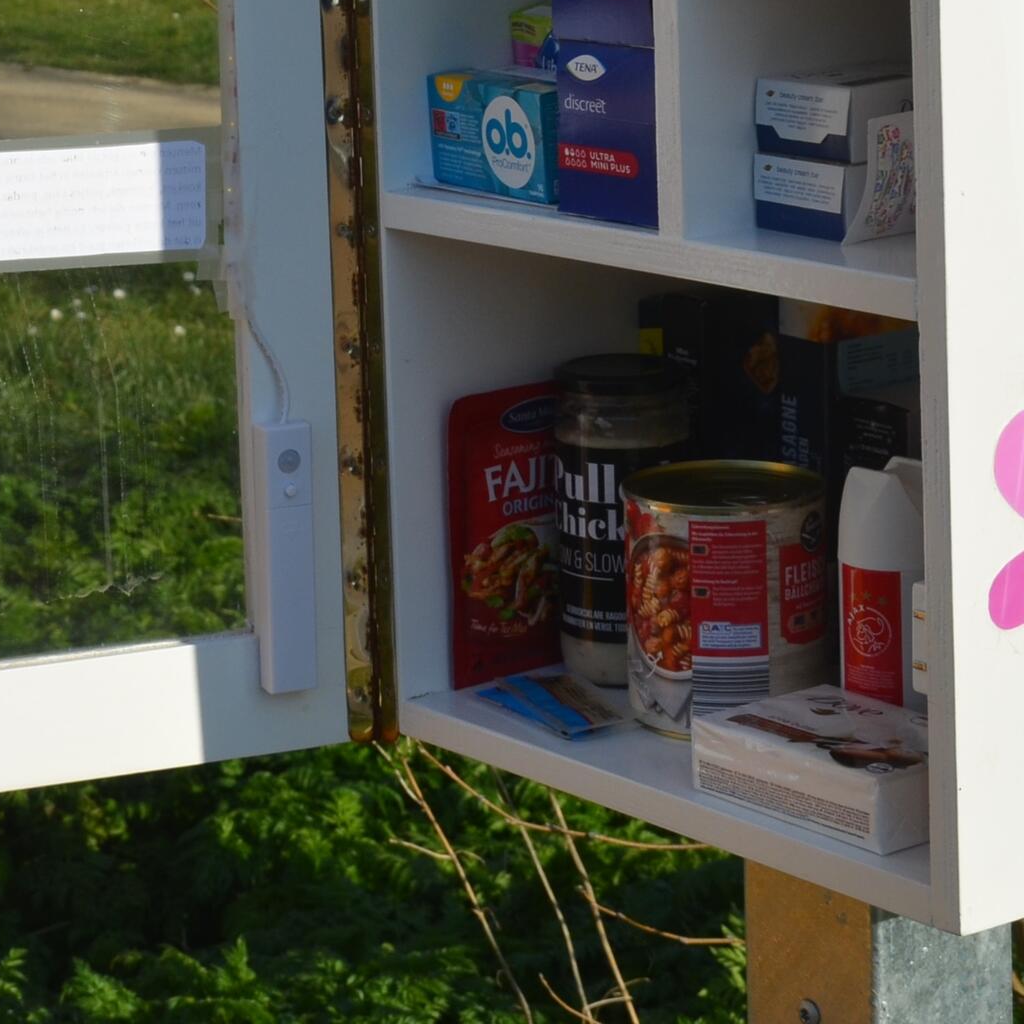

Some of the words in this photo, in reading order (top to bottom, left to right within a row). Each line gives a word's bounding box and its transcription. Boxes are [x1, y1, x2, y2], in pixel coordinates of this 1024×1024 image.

[574, 61, 597, 74] TENA
[564, 95, 607, 115] discreet
[492, 156, 529, 173] ProComfort
[589, 151, 615, 162] ULTRA
[589, 161, 609, 171] MINI
[610, 163, 631, 174] PLUS
[780, 392, 798, 462] SAGNE
[554, 456, 624, 504] Pull
[574, 549, 583, 569] &
[584, 551, 625, 574] SLOW
[847, 604, 865, 625] AJAX
[806, 695, 884, 716] Dove
